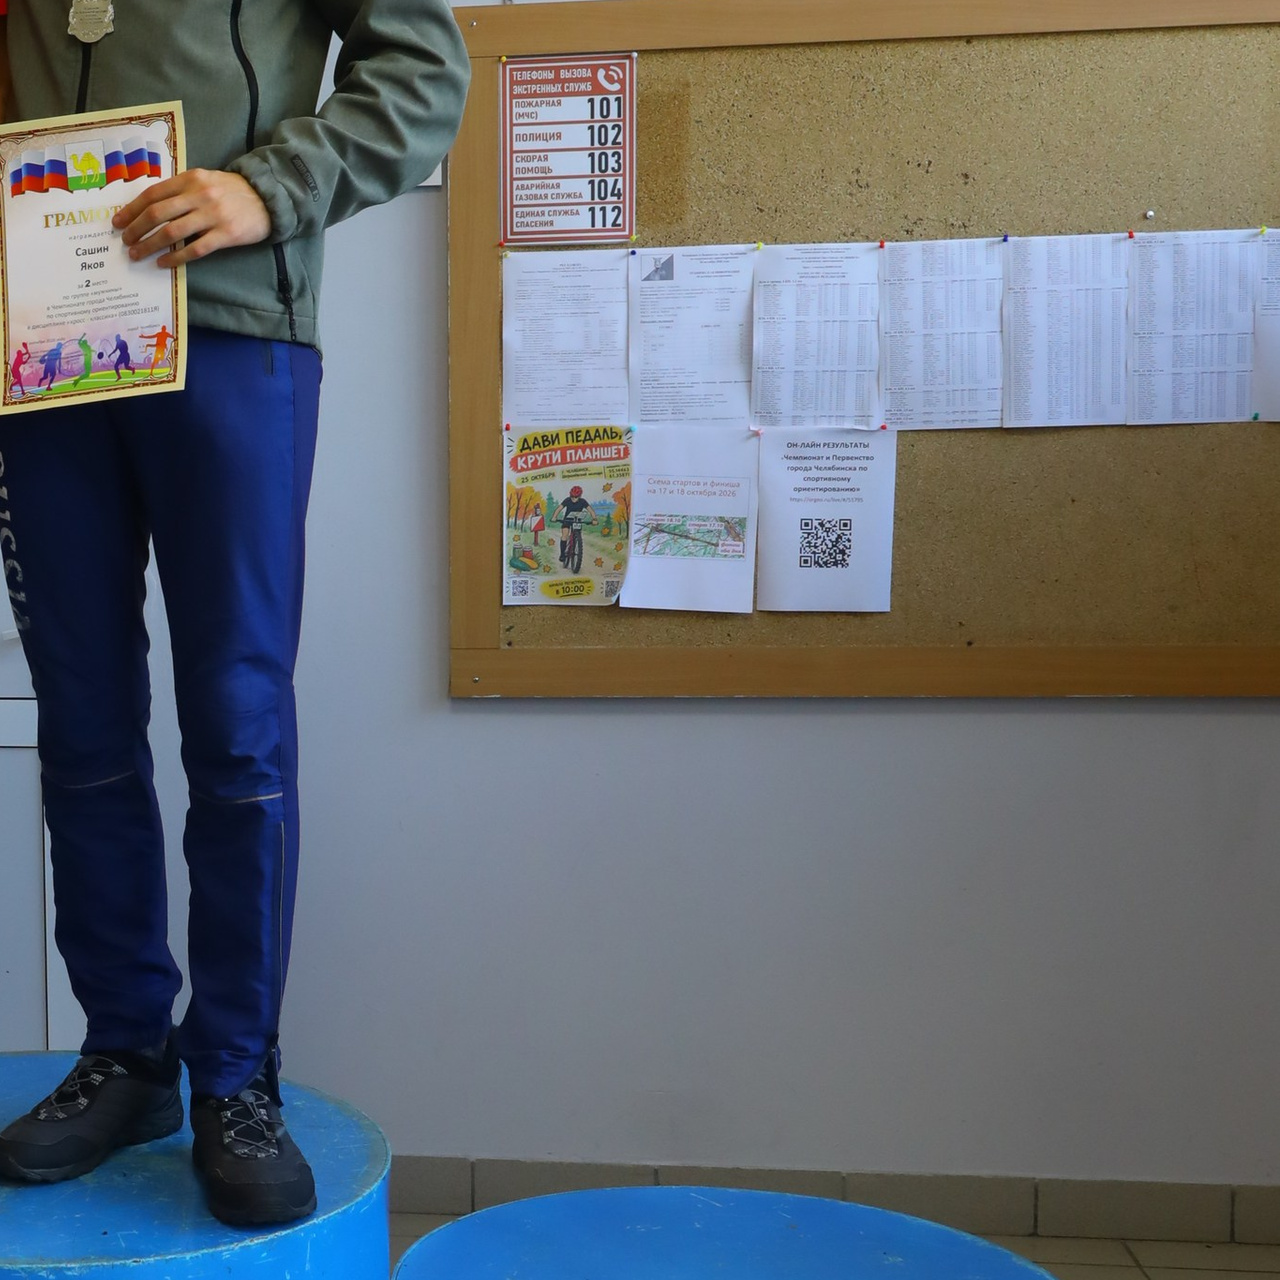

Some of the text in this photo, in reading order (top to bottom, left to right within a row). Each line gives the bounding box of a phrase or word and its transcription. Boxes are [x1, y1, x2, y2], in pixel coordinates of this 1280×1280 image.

[512, 68, 592, 81] ТЕЛЕФОНЫ ВЫЗОВА
[512, 82, 592, 95] ЭКСТРЕННЫХ СЛУЖБ
[515, 99, 562, 109] ПОЖАРНАЯ
[587, 96, 622, 120] 101
[515, 111, 538, 121] (МЧС)
[515, 132, 562, 143] ПОЛИЦИЯ
[587, 123, 622, 147] 102
[515, 154, 549, 163] СКОРАЯ
[587, 151, 622, 174] 103
[515, 166, 553, 175] ПОМОЩЬ
[515, 181, 561, 191] АВАРИЙНАЯ
[587, 178, 623, 201] 104
[515, 192, 583, 202] ГАЗОВАЯ СЛУЖБА
[43, 205, 122, 229] ГРАМОТ
[515, 209, 580, 219] ЕДИНАЯ СЛУЖБА
[588, 205, 622, 228] 112
[515, 220, 554, 229] СПАСЕНИЯ
[69, 230, 115, 241] награждается
[75, 245, 109, 257] Сашин
[80, 261, 105, 271] Яков
[84, 280, 91, 288] 2
[51, 301, 86, 310] Чемпионате
[86, 298, 105, 306] города
[106, 293, 139, 302] Челябинска
[70, 292, 90, 301] группе
[54, 309, 91, 319] спортивному
[92, 301, 140, 313] ориентированию
[31, 320, 66, 331] дисциплине
[520, 427, 623, 453] ДАВИ ПЕДАЛЬ,
[786, 441, 821, 449] ОН-ЛАЙН
[517, 445, 626, 470] КРУТИ ПЛАНШЕТ
[521, 476, 529, 484] 25
[530, 472, 556, 481] ОКТЯБРЯ
[647, 477, 671, 486] Схема
[672, 479, 701, 488] стартов
[709, 480, 741, 488] финиша
[686, 489, 717, 497] октября
[561, 584, 585, 594] 10:00
